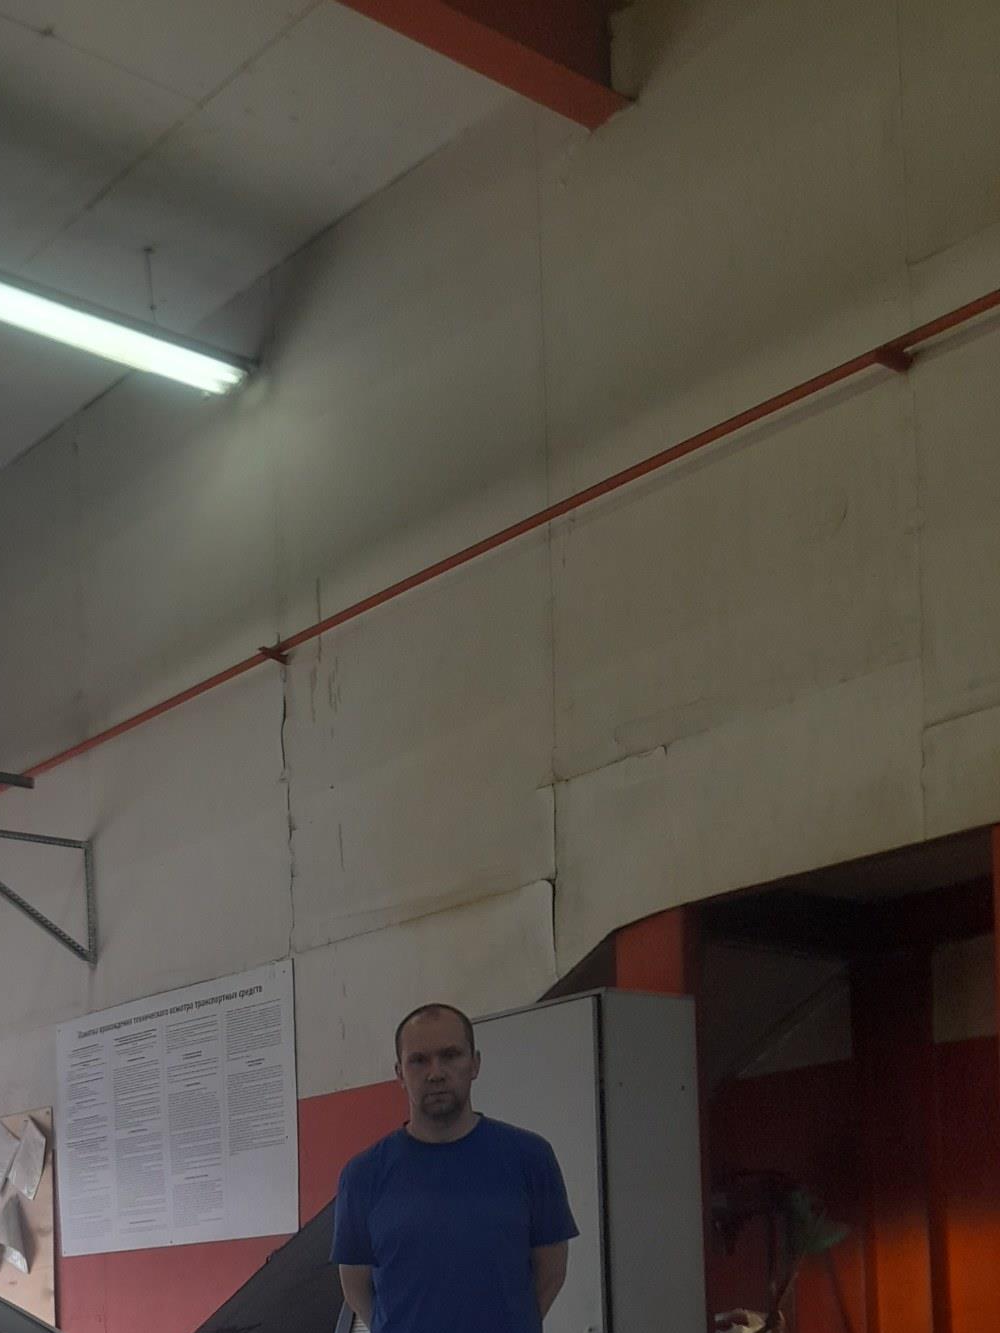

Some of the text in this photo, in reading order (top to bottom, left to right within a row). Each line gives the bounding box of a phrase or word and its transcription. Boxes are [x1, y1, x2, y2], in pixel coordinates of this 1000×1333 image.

[169, 1001, 194, 1016] осмотра
[194, 991, 238, 1009] транспортных
[238, 985, 263, 998] средств
